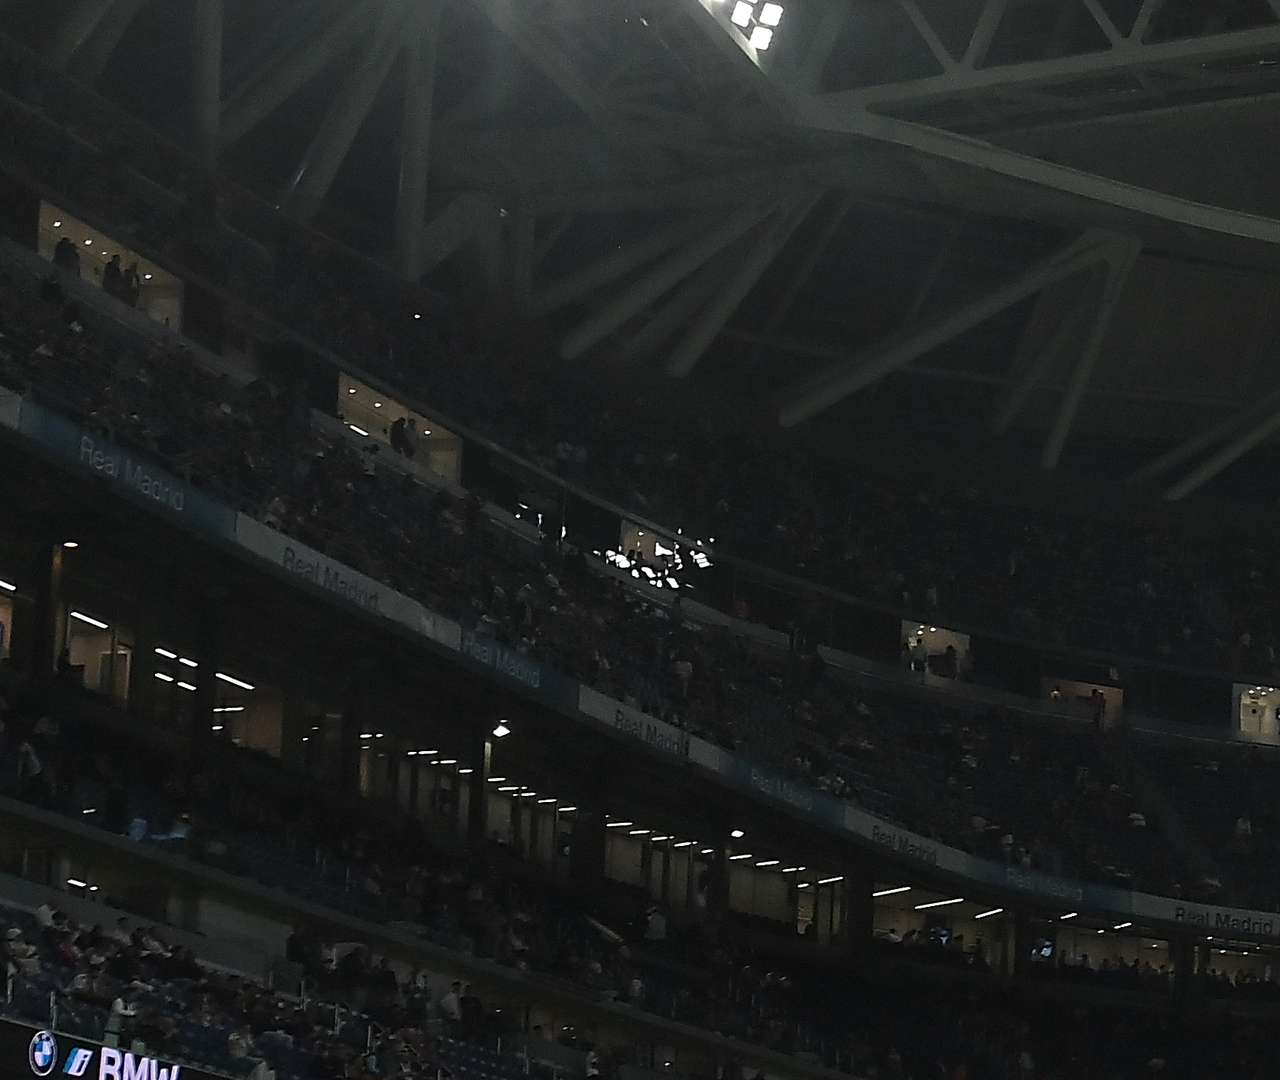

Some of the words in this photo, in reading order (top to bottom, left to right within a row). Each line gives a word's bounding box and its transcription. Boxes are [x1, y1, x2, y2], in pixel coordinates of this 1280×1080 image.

[81, 436, 122, 478] Real
[1175, 906, 1209, 926] Real
[1216, 912, 1273, 935] Madrid
